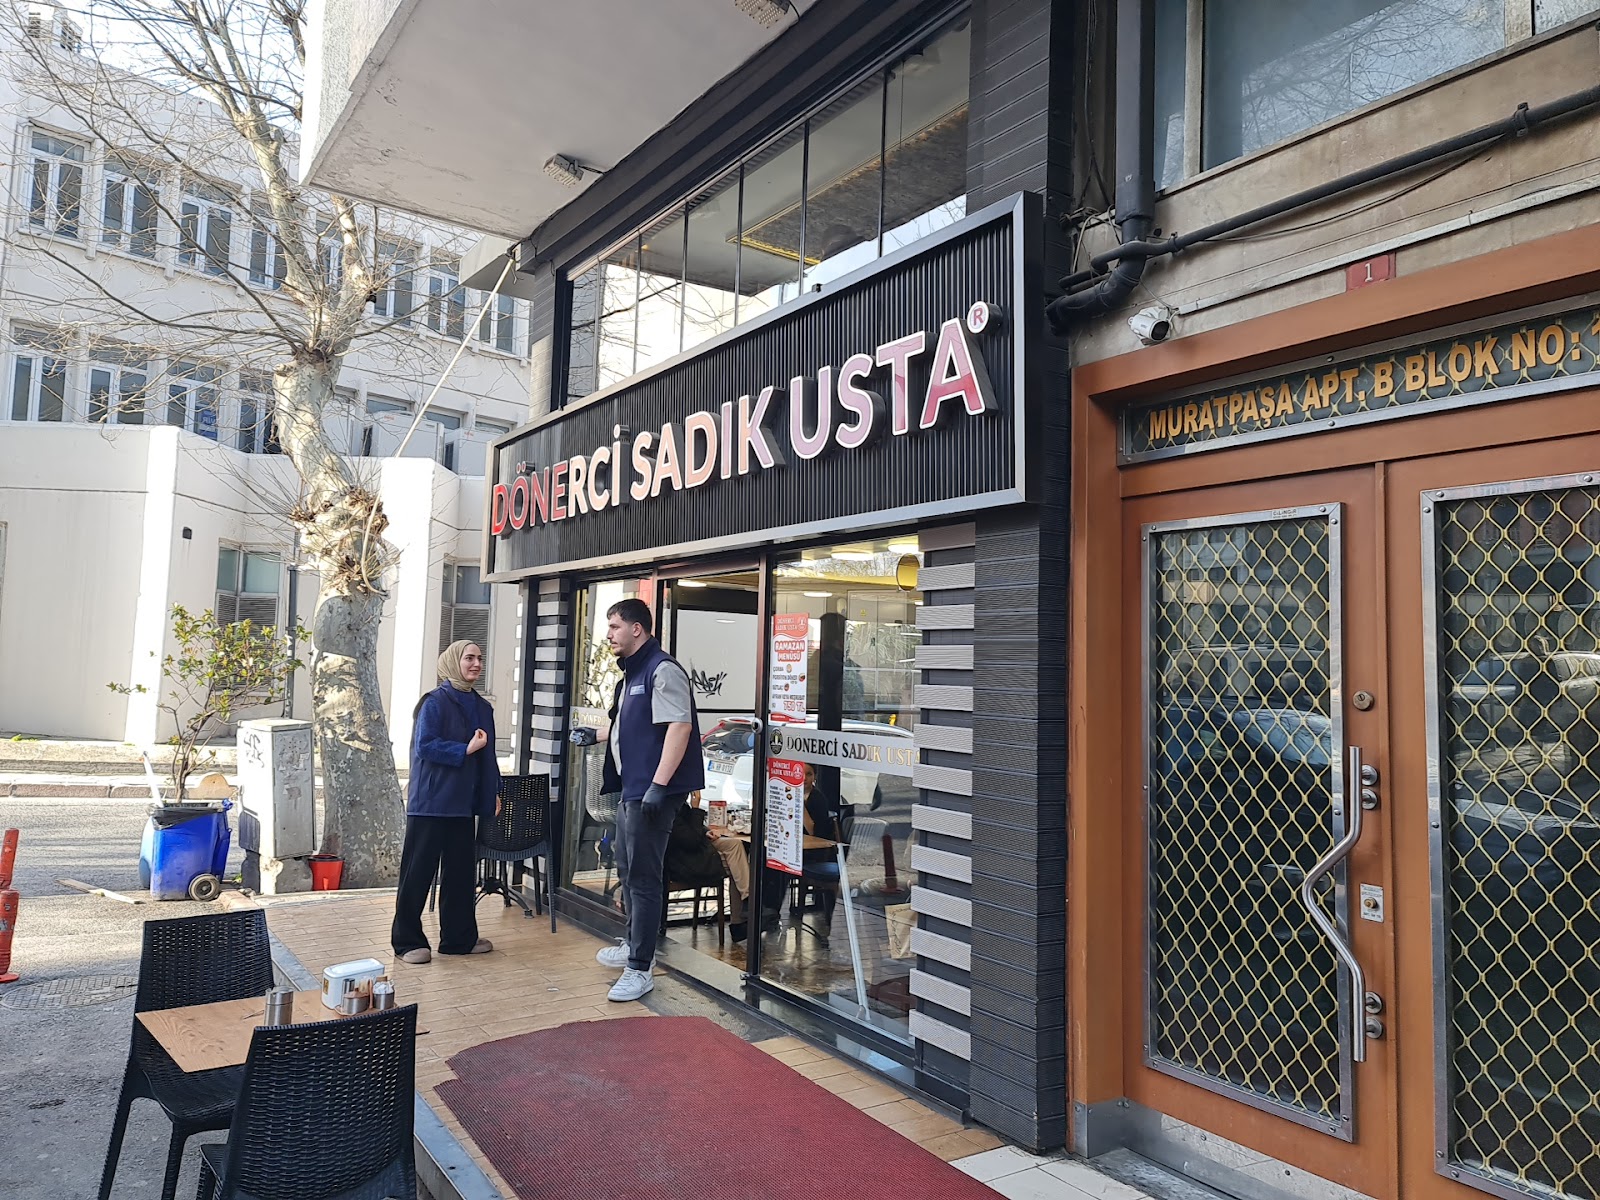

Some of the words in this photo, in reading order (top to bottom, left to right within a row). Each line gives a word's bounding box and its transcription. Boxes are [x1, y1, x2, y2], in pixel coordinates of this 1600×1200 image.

[1364, 262, 1374, 282] 1
[1149, 383, 1295, 441] MURATPAŞA
[1301, 367, 1367, 412] APT.
[1373, 361, 1395, 399] B
[1404, 336, 1500, 392] BLOK
[491, 423, 622, 536] DÖNERCİ
[629, 385, 775, 501] SADIK
[789, 317, 986, 460] USTA
[775, 641, 805, 651] RAMAZAN
[778, 650, 801, 661] MENÜSÜ
[842, 742, 882, 763] SADIK
